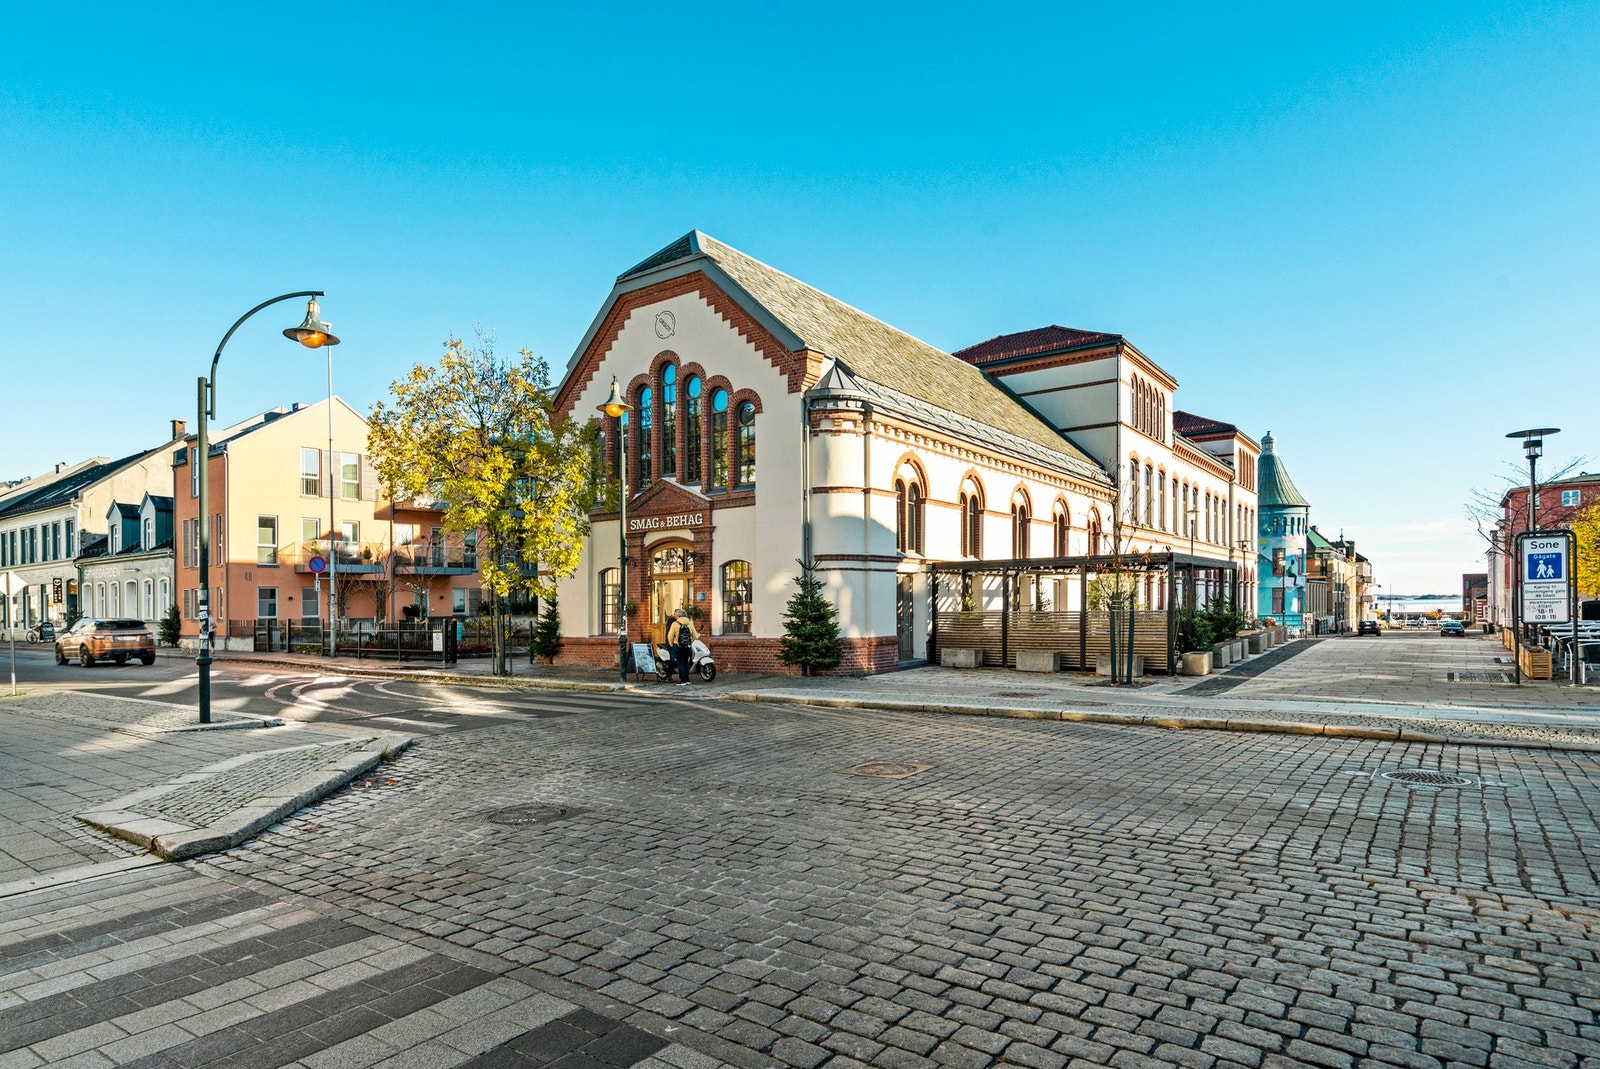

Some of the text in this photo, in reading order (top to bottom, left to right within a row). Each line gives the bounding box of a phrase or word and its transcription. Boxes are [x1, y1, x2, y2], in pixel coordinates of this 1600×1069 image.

[630, 513, 703, 530] SMAG & BEHAG
[1530, 541, 1559, 549] Sone
